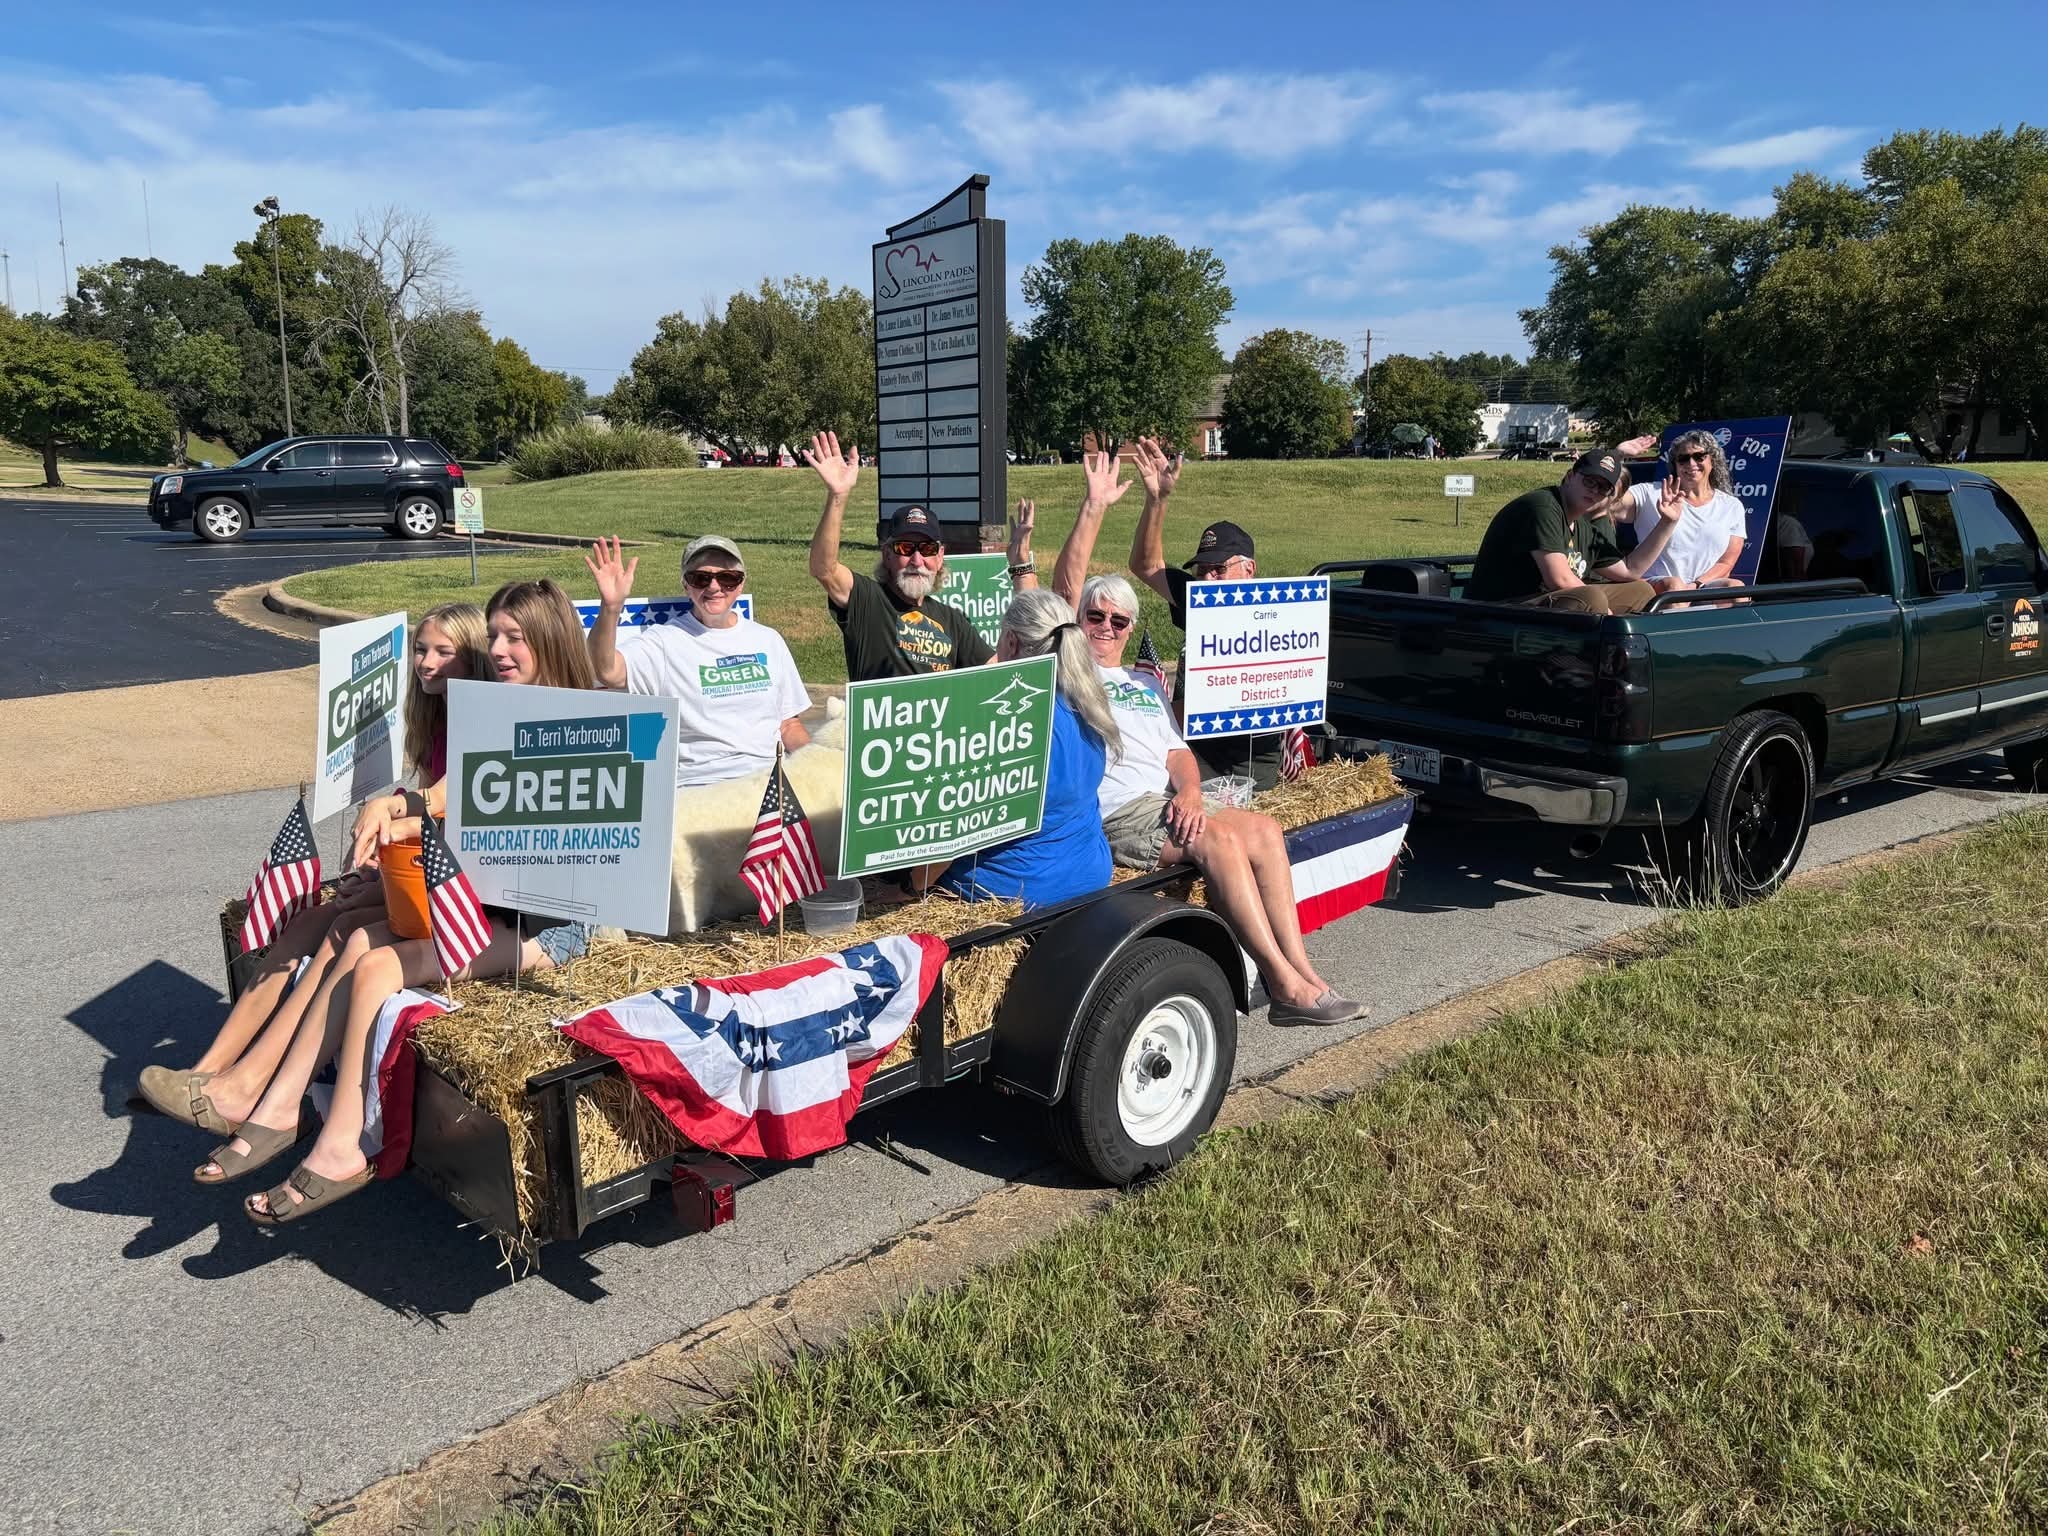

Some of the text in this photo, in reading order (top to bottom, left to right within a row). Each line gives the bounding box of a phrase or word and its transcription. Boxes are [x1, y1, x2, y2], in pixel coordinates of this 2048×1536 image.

[902, 264, 975, 288] LINCOLN PADEN
[939, 309, 951, 321] James
[895, 424, 973, 440] Accepting New Patients
[1740, 436, 1770, 458] FOR
[943, 570, 971, 592] ary
[1253, 609, 1278, 620] Carrie
[2011, 620, 2039, 637] JOHNSON
[361, 650, 371, 669] Terri
[371, 637, 391, 664] Yarbrough
[1201, 629, 1319, 657] Huddleston
[704, 665, 765, 683] GREEN
[1206, 674, 1237, 687] State
[1240, 666, 1313, 685] Representative
[332, 668, 394, 738] GREEN
[1241, 686, 1287, 702] District 3
[863, 695, 950, 731] Mary
[1505, 708, 1585, 729] CHEVROLET
[519, 723, 620, 748] Dr. Terri Yarbrough
[860, 716, 1033, 778] O'Shields
[1414, 756, 1436, 777] VCE
[471, 760, 627, 815] GREEN
[858, 765, 1038, 825] CITY COUNCIL
[896, 805, 1008, 845] VOTE NOV 3
[461, 826, 640, 852] DEMOCRAT FOR ARKANSAS
[880, 853, 895, 861] Paid
[981, 831, 993, 839] Mary
[479, 854, 620, 866] CONGRESSIONAL DISTRICT ONE
